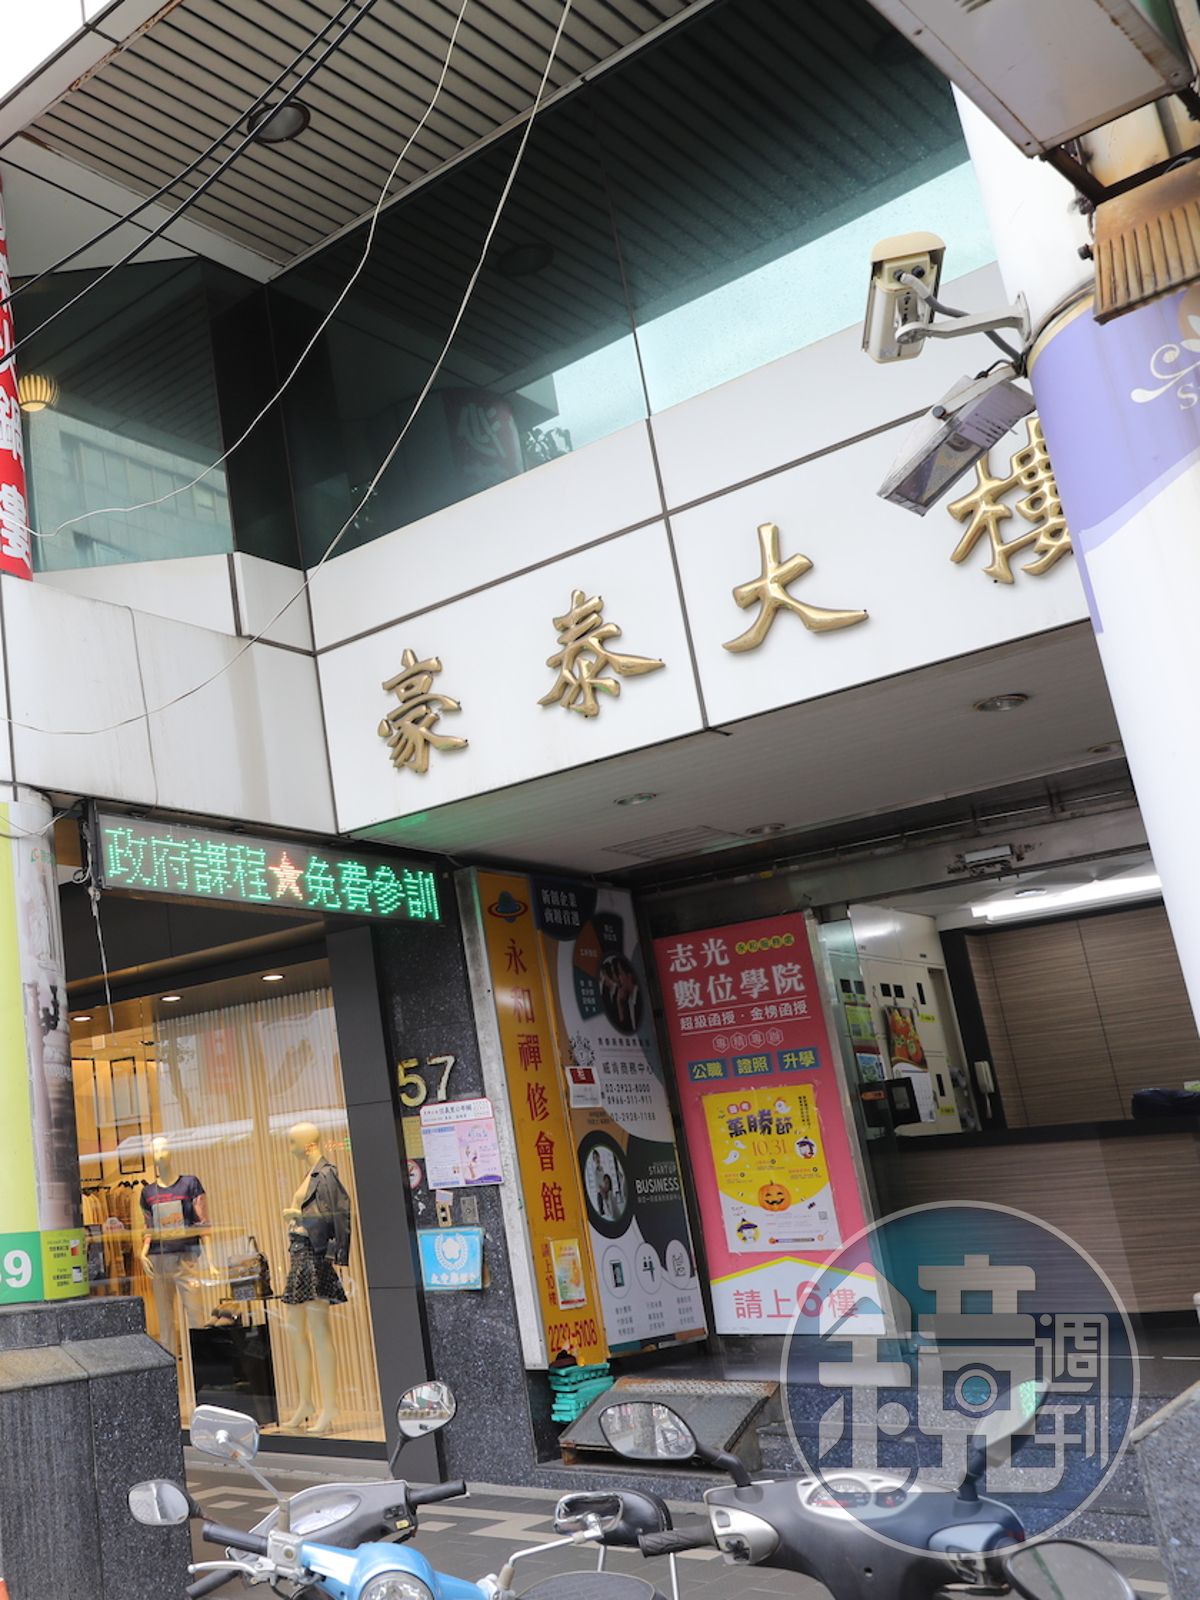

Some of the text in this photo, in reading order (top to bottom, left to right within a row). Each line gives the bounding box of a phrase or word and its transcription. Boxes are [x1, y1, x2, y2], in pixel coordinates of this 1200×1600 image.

[105, 827, 440, 921] 政府課程 免費參訓
[667, 938, 730, 972] 志光
[673, 963, 805, 1010] 數位學院
[398, 1055, 456, 1107] 57
[504, 938, 566, 1222] 永和禪修會館
[693, 1050, 816, 1080] 公職 證照 升學
[635, 1177, 680, 1194] BUSINESS
[733, 1280, 859, 1321] 請上6樓
